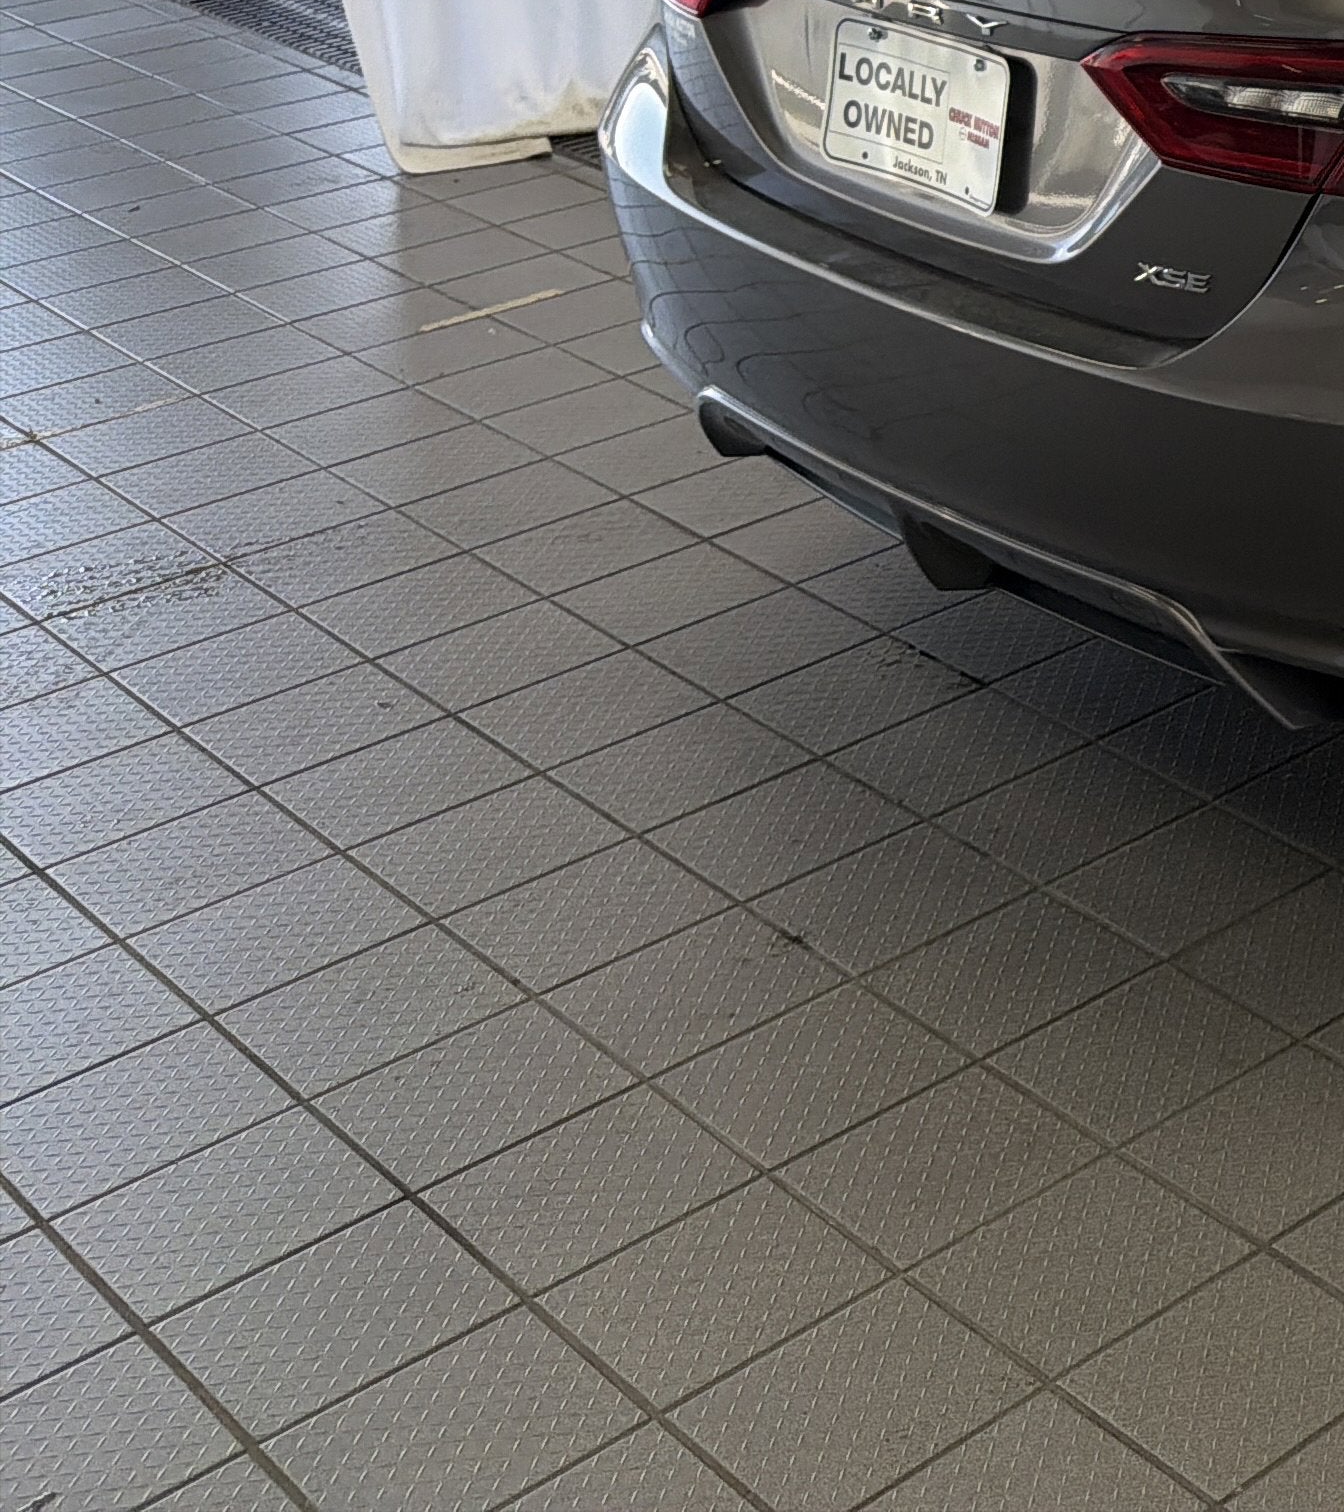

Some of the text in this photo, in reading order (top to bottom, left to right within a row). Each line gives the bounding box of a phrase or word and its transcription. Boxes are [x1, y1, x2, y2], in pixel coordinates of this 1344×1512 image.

[839, 52, 947, 107] LOCALLY
[843, 99, 934, 150] OWNED
[893, 155, 948, 185] Jackson, TN
[1133, 261, 1211, 293] XSE
